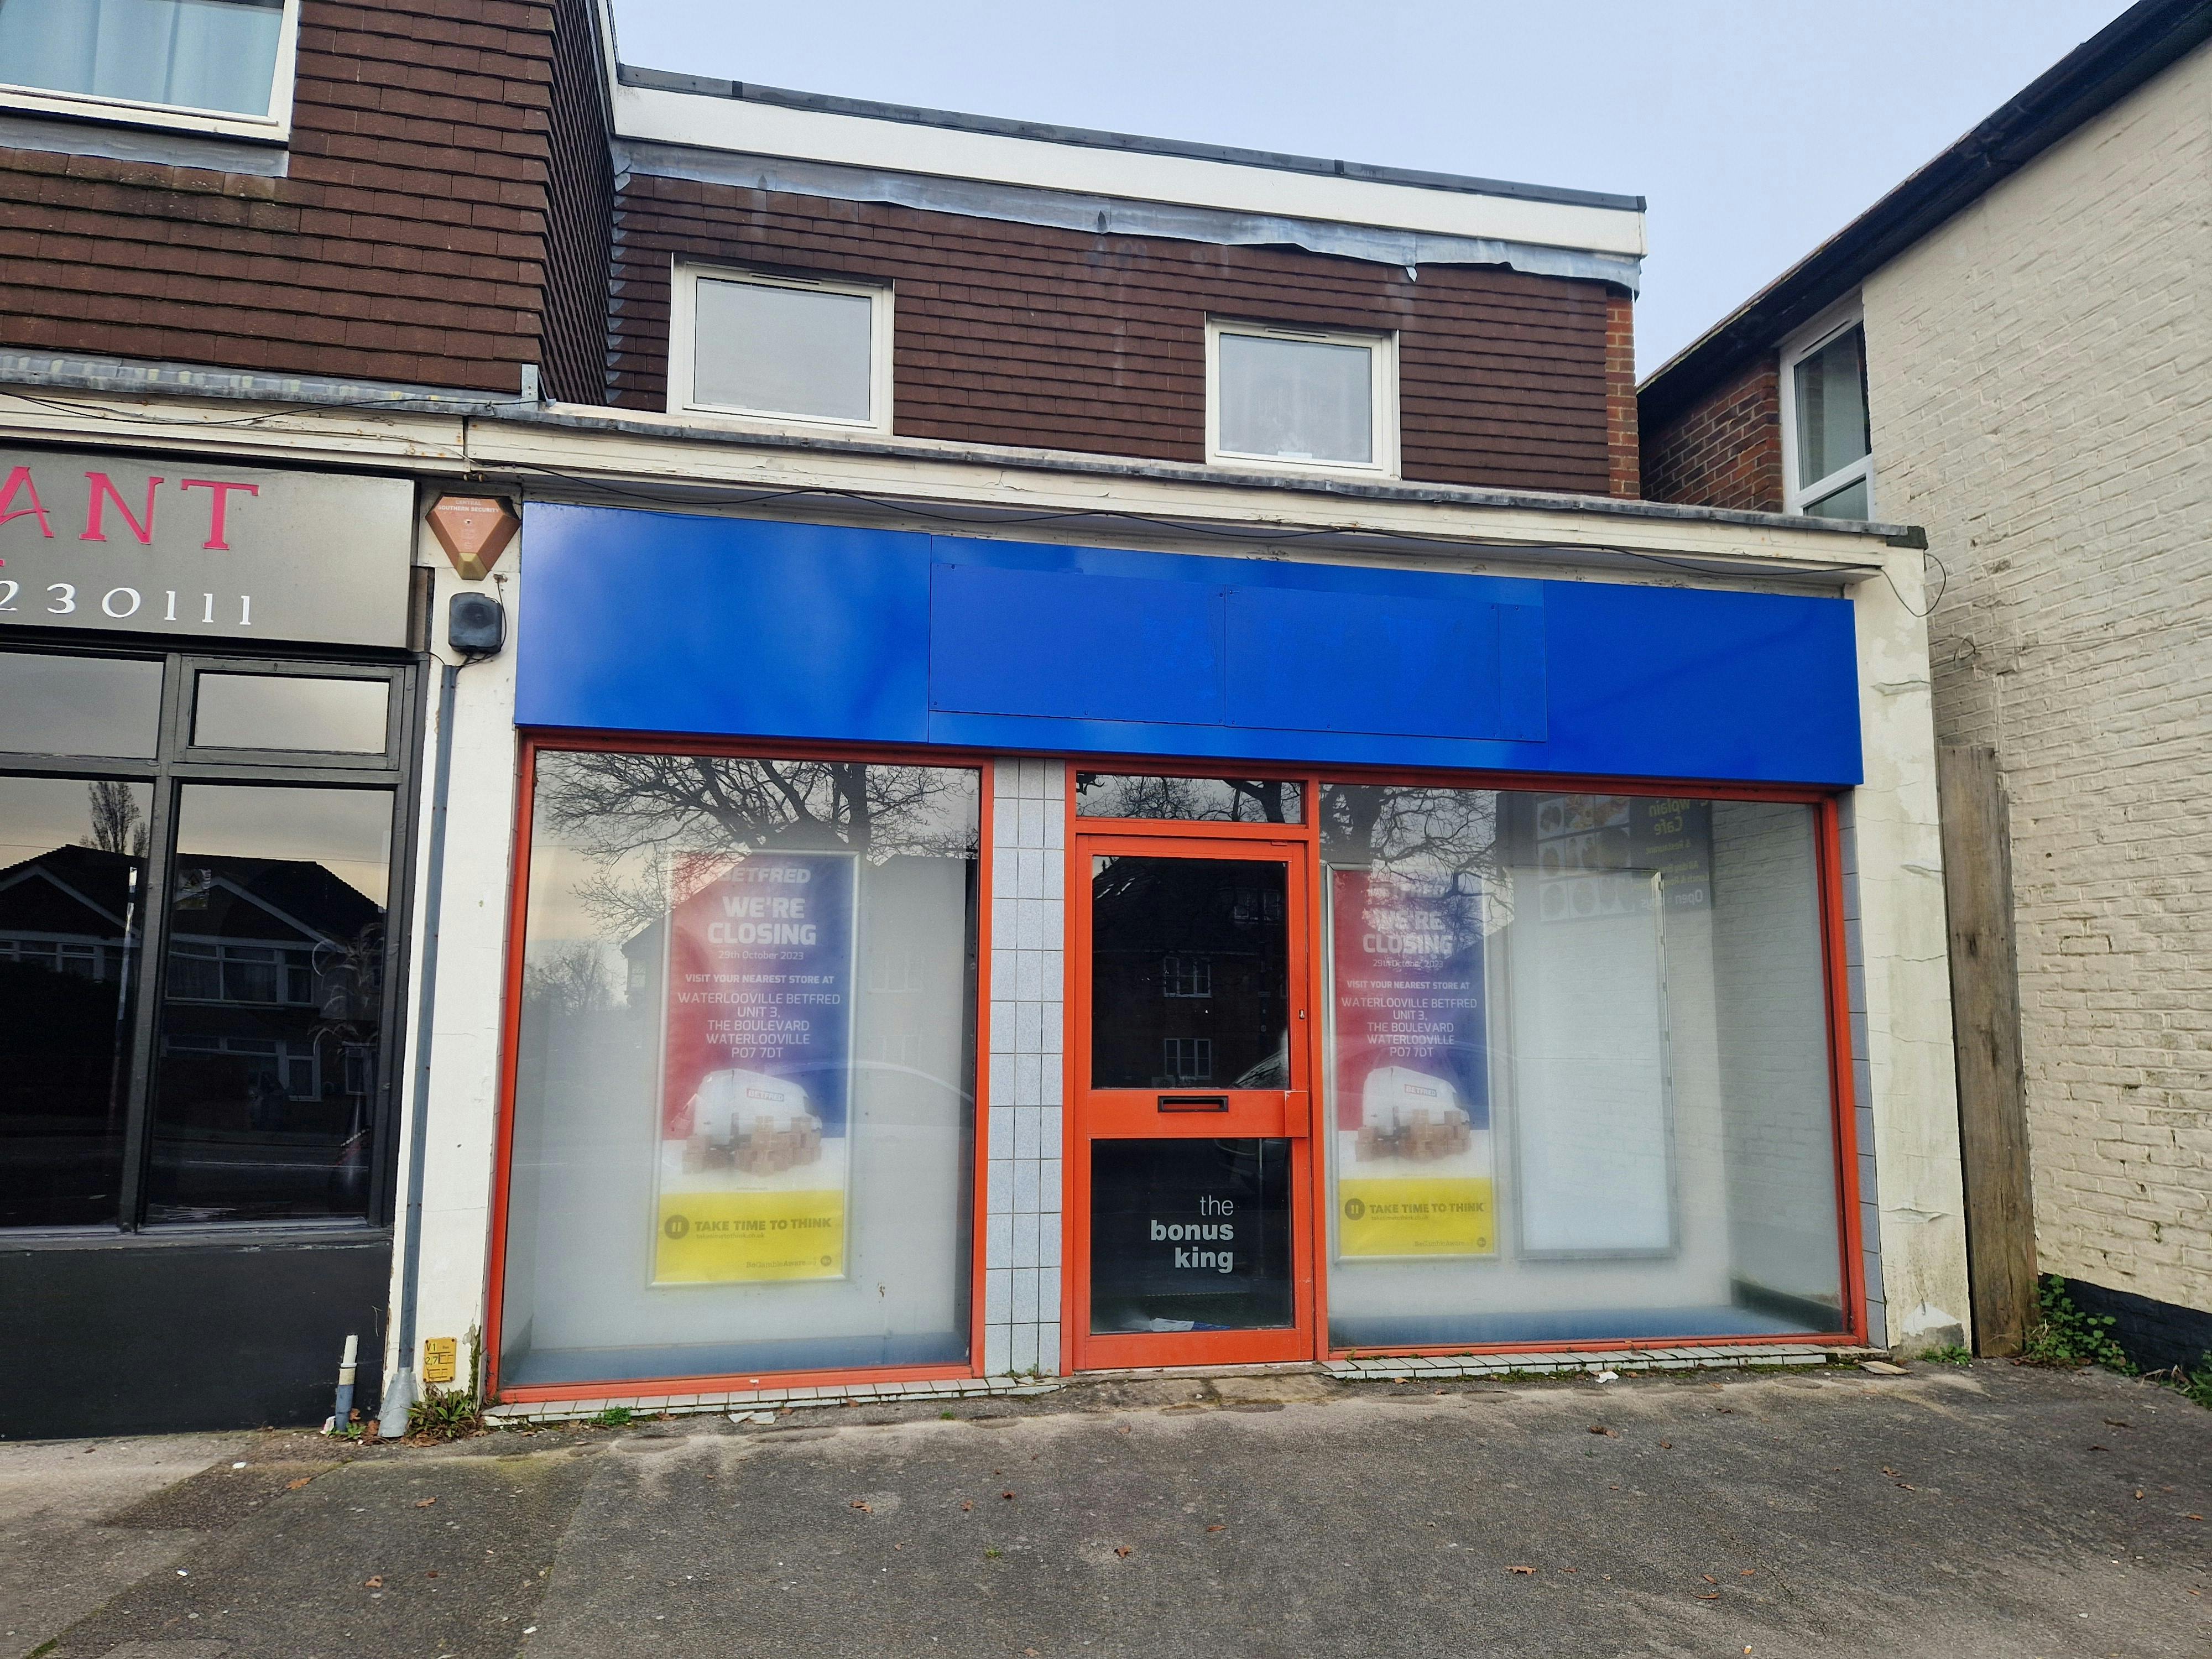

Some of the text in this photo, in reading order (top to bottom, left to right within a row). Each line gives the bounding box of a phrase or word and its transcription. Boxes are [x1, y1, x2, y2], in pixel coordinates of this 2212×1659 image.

[720, 867, 811, 884] BETFRED
[722, 896, 805, 919] WE'RE
[707, 922, 817, 945] CLOSING
[1362, 934, 1454, 954] CLOSING
[719, 951, 804, 961] 29th October 2023
[685, 973, 834, 984] VISIT YOUR NEAREST STORE AT
[1347, 980, 1368, 988] VISIT
[677, 992, 841, 1005] WATERLOOVILLE BETFRED
[1341, 997, 1477, 1008] WATERLOOVILLE BETFRED
[737, 1007, 766, 1018] UNIT
[1393, 1010, 1416, 1020] UNIT
[708, 1020, 810, 1031] THE BOULEVARD
[1368, 1022, 1454, 1032] THE BOULEVARD
[706, 1034, 810, 1045] WATERLOOVILLE
[1367, 1035, 1455, 1045] WATERLOOVILLE
[760, 1047, 784, 1058] 7DT
[1414, 1047, 1434, 1057] 7DT
[748, 1089, 784, 1101] BETFRED
[1405, 1084, 1437, 1097] BETFRED
[1199, 1194, 1234, 1215] the
[1370, 1202, 1484, 1214] TAKE TIME TO THINK
[695, 1218, 832, 1232] TAKE TIME TO THINK
[1150, 1219, 1234, 1241] bonus
[1175, 1246, 1234, 1274] king
